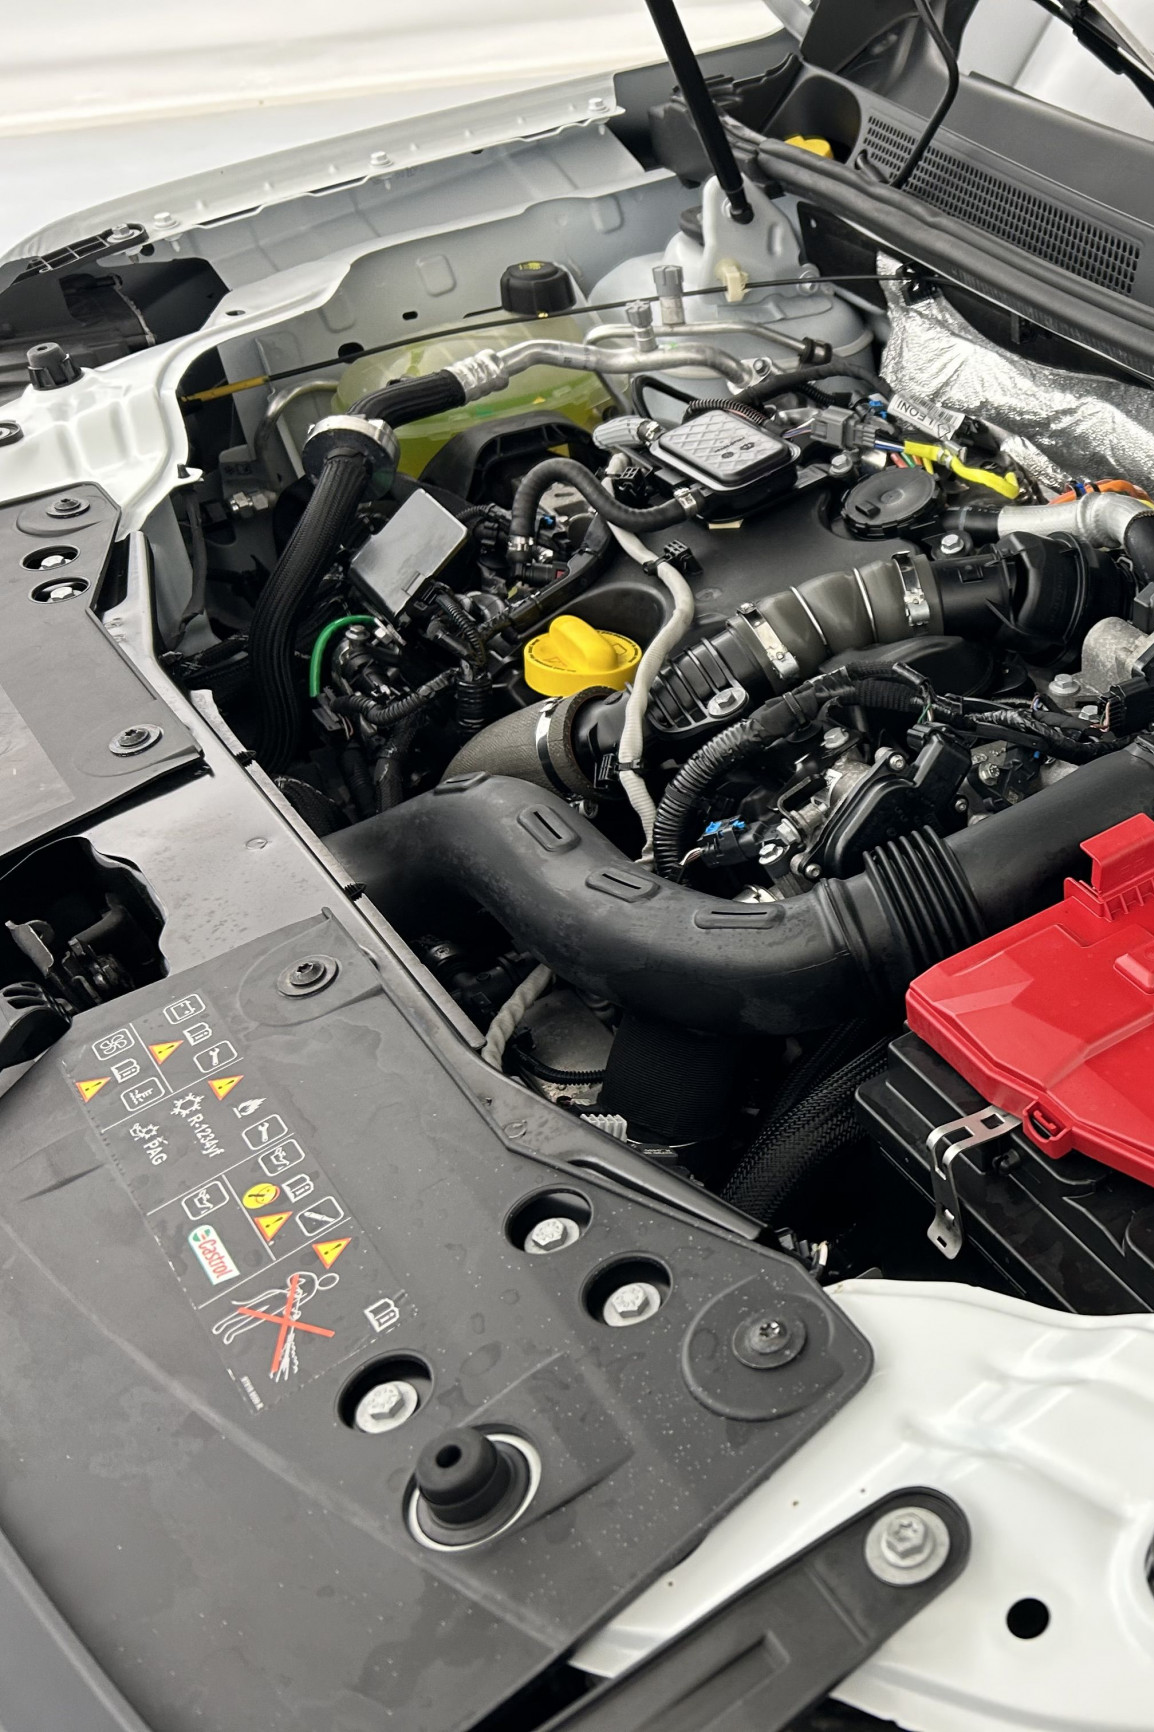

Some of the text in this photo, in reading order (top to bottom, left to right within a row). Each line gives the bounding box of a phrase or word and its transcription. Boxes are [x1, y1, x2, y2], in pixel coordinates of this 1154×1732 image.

[896, 400, 936, 426] LEONI
[144, 1138, 168, 1166] PAG
[187, 1113, 225, 1158] R-1234yf
[197, 1238, 233, 1280] Castrol
